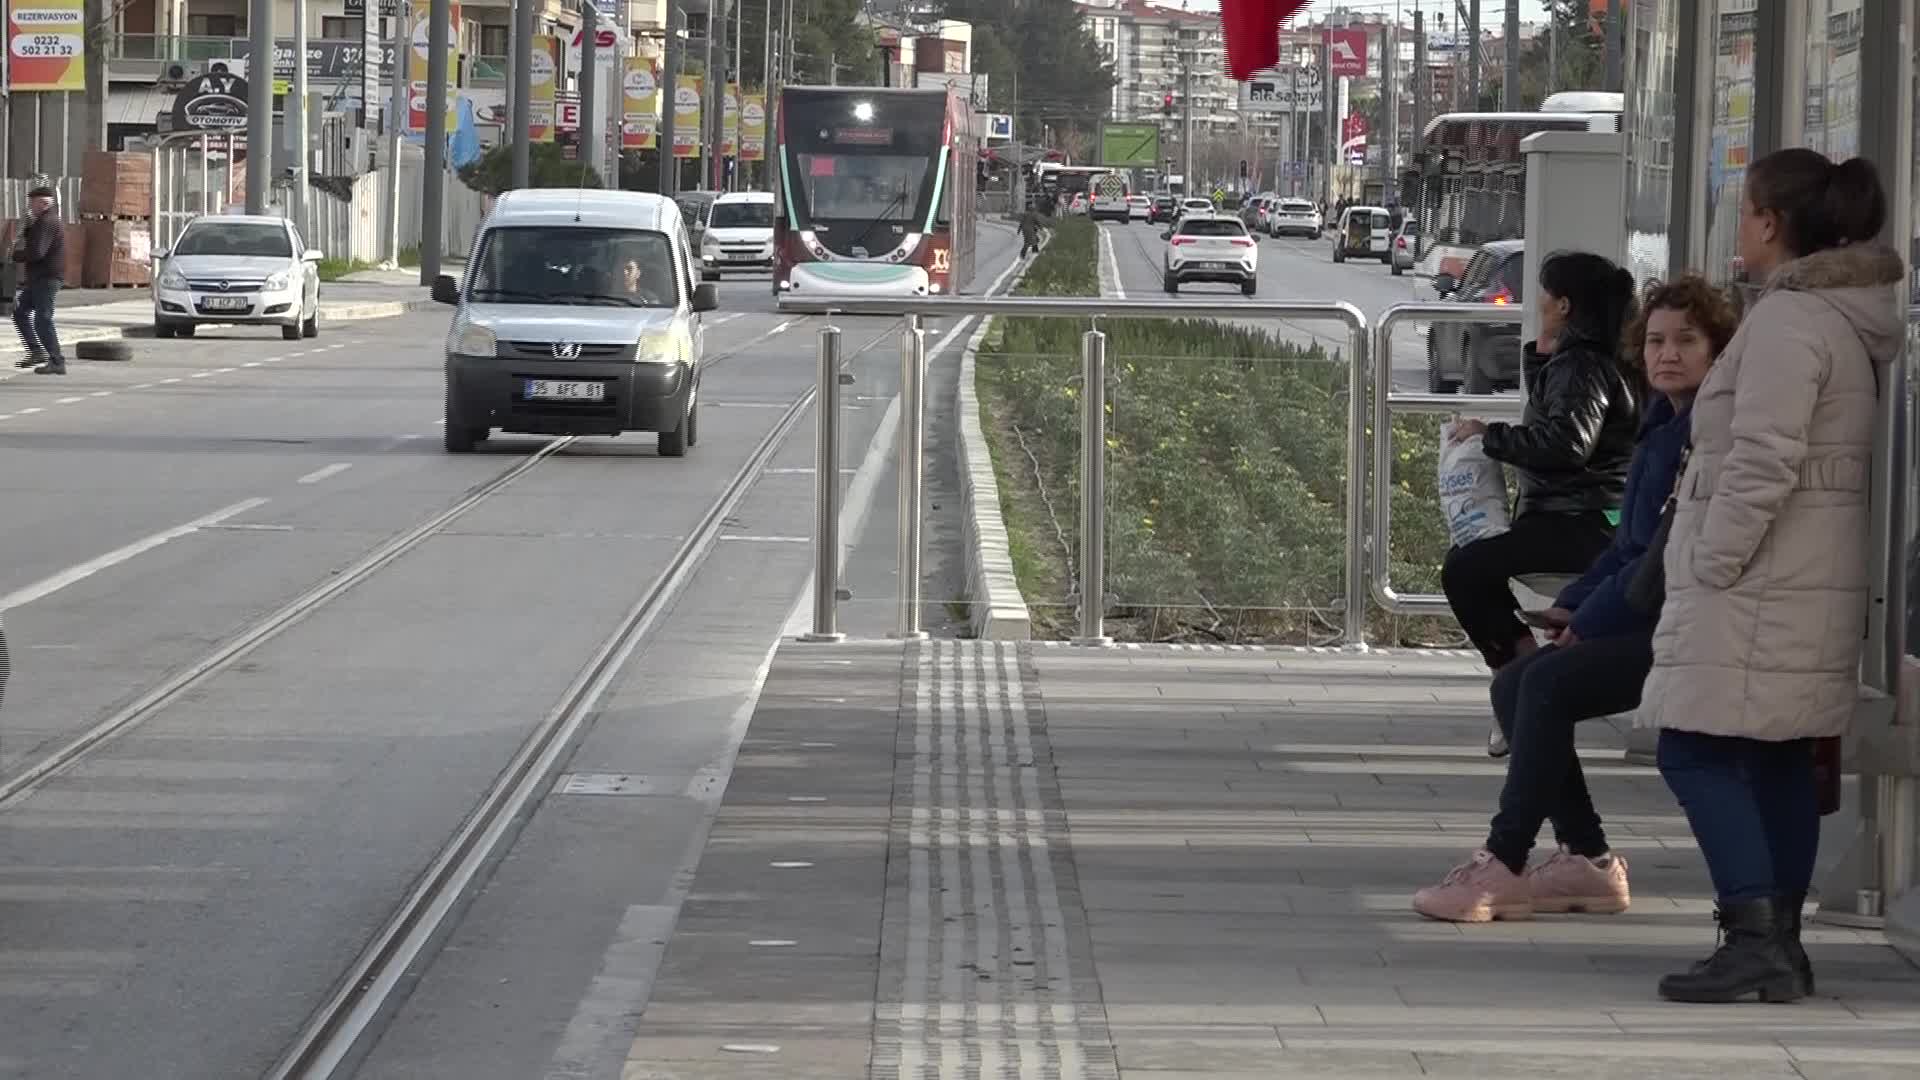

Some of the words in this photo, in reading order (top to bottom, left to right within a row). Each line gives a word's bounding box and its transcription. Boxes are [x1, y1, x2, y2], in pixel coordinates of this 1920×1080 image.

[17, 12, 78, 21] REZERVASYON
[34, 35, 60, 46] 0232
[21, 46, 41, 55] 502
[44, 46, 56, 55] 21
[60, 46, 73, 55] 32
[563, 106, 577, 123] E
